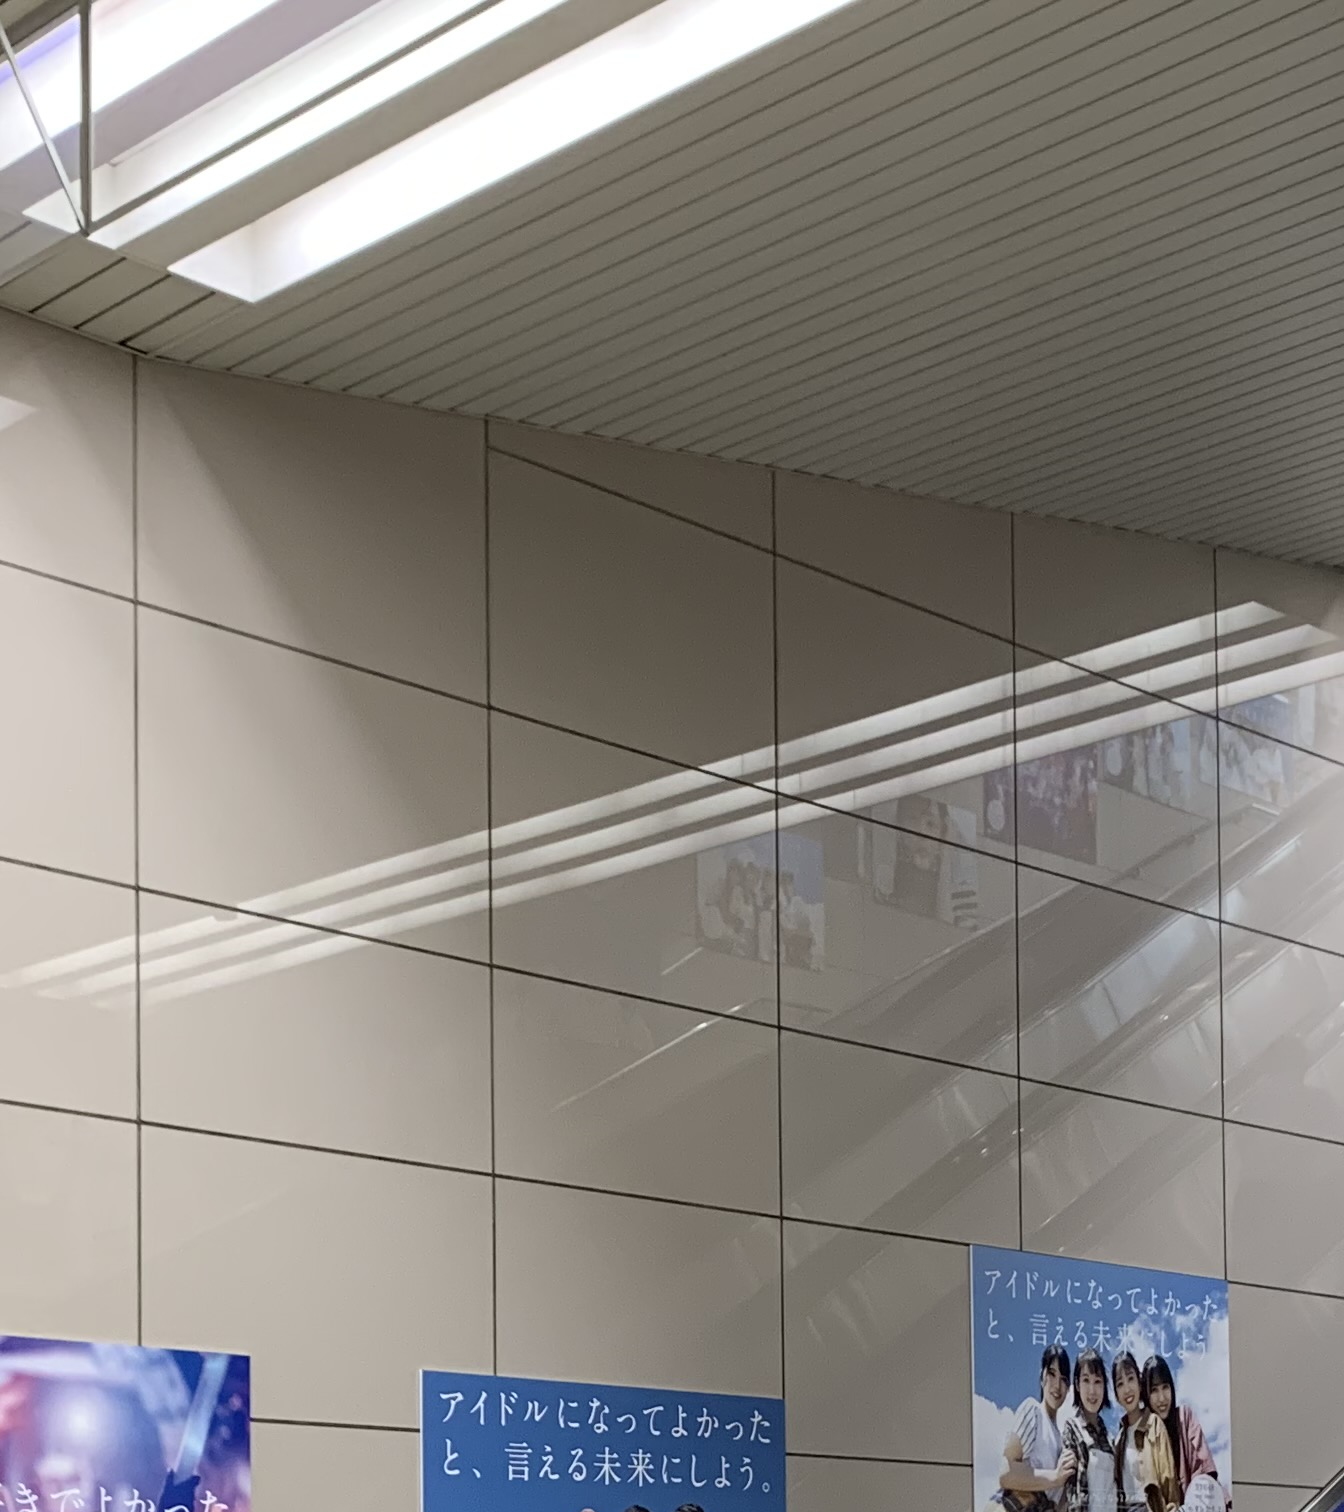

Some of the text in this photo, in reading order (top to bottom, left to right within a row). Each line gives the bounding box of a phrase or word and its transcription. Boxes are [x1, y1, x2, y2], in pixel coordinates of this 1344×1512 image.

[984, 1269, 1218, 1320] アイドルになってよかった
[439, 1391, 771, 1444] アイドルになってよかった
[442, 1439, 770, 1494] と、言える未来にしよう。
